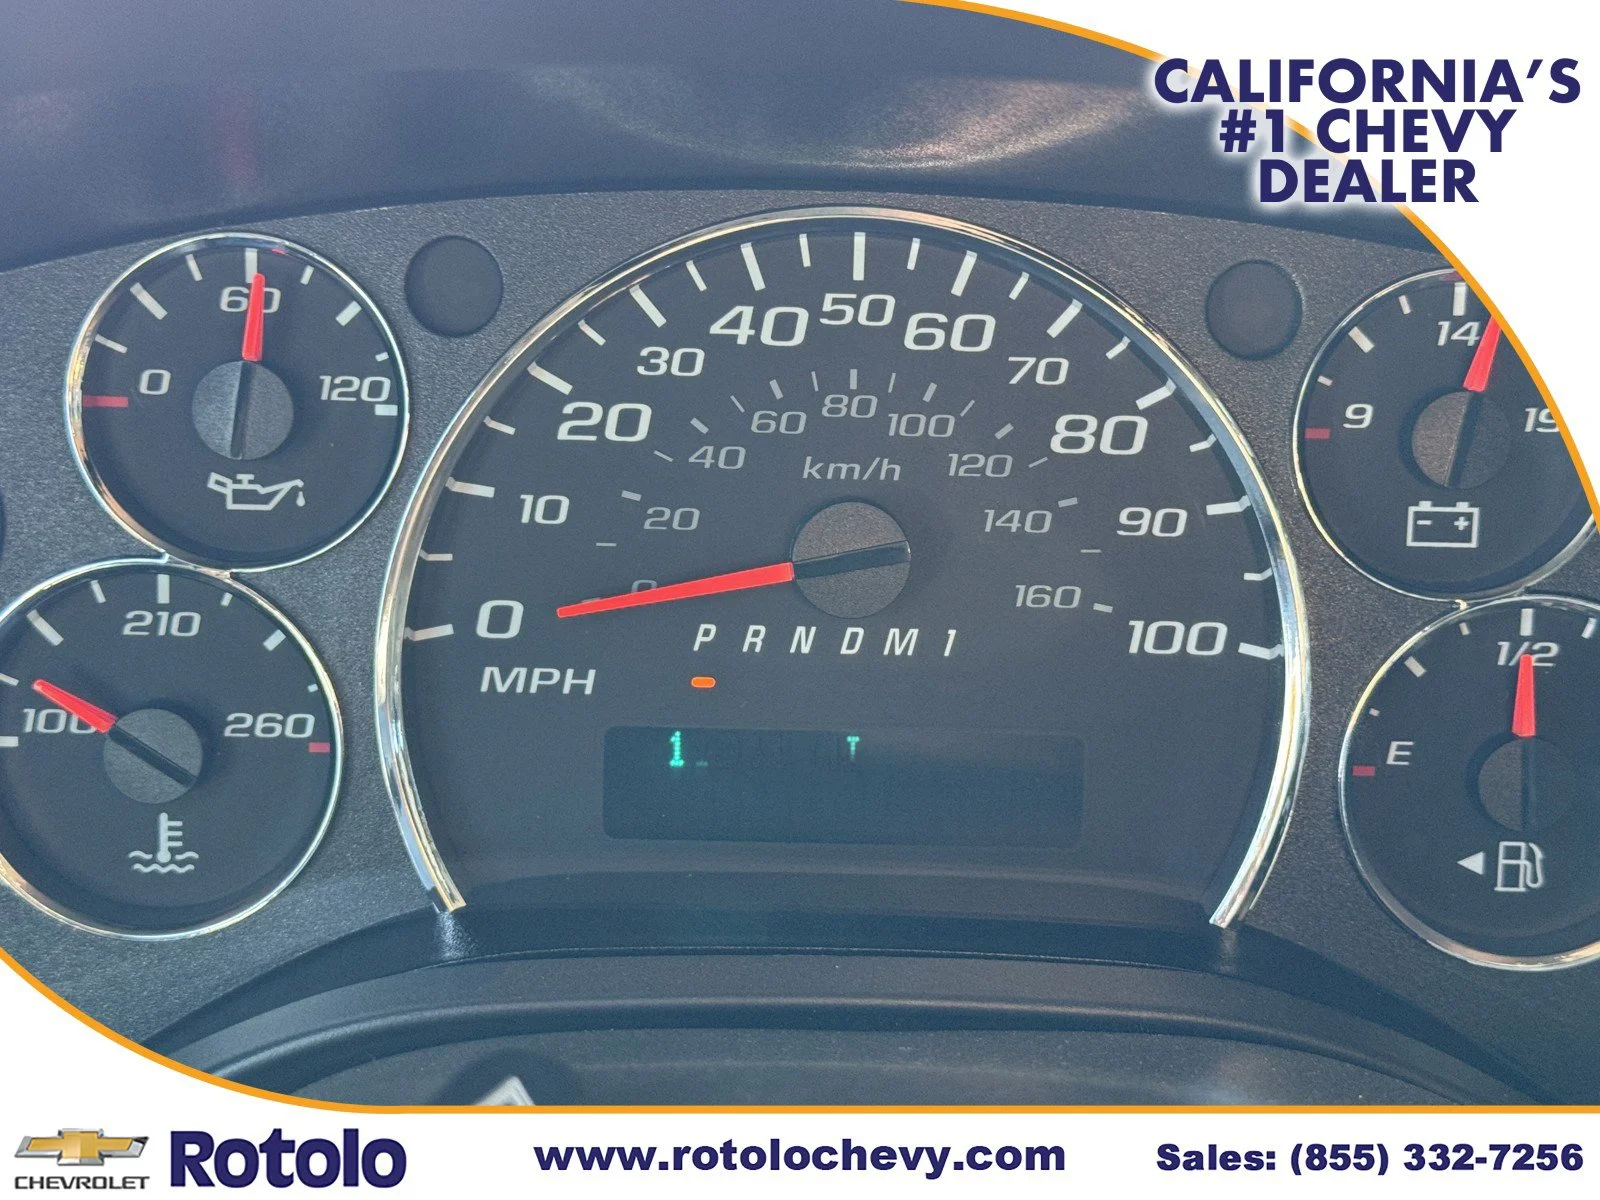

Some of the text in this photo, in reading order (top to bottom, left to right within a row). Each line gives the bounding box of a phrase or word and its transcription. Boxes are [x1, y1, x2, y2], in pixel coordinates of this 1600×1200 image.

[819, 293, 895, 326] 50
[709, 306, 809, 346] 40
[903, 313, 996, 352] 60
[1436, 320, 1482, 346] 14
[637, 346, 705, 377] 30
[1007, 357, 1070, 385] 70
[138, 368, 171, 396] 0
[319, 375, 391, 402] 120
[821, 395, 877, 419] 80
[1342, 403, 1374, 429] 9
[557, 402, 652, 441] 20
[751, 411, 806, 435] 60
[887, 413, 956, 438] 100
[1050, 415, 1148, 456] 80
[688, 446, 746, 470] 40
[802, 456, 902, 484] km/h
[947, 453, 1014, 478] 120
[519, 495, 571, 524] 10
[643, 507, 700, 531] 20
[983, 509, 1053, 534] 140
[1116, 507, 1188, 538] 90
[1014, 584, 1082, 609] 160
[122, 610, 202, 637] 210
[476, 600, 525, 639] 0
[1128, 620, 1229, 656] 100
[1496, 640, 1559, 667] 1/2
[480, 666, 596, 695] MPH
[223, 713, 316, 739] 260
[1386, 741, 1415, 766] E
